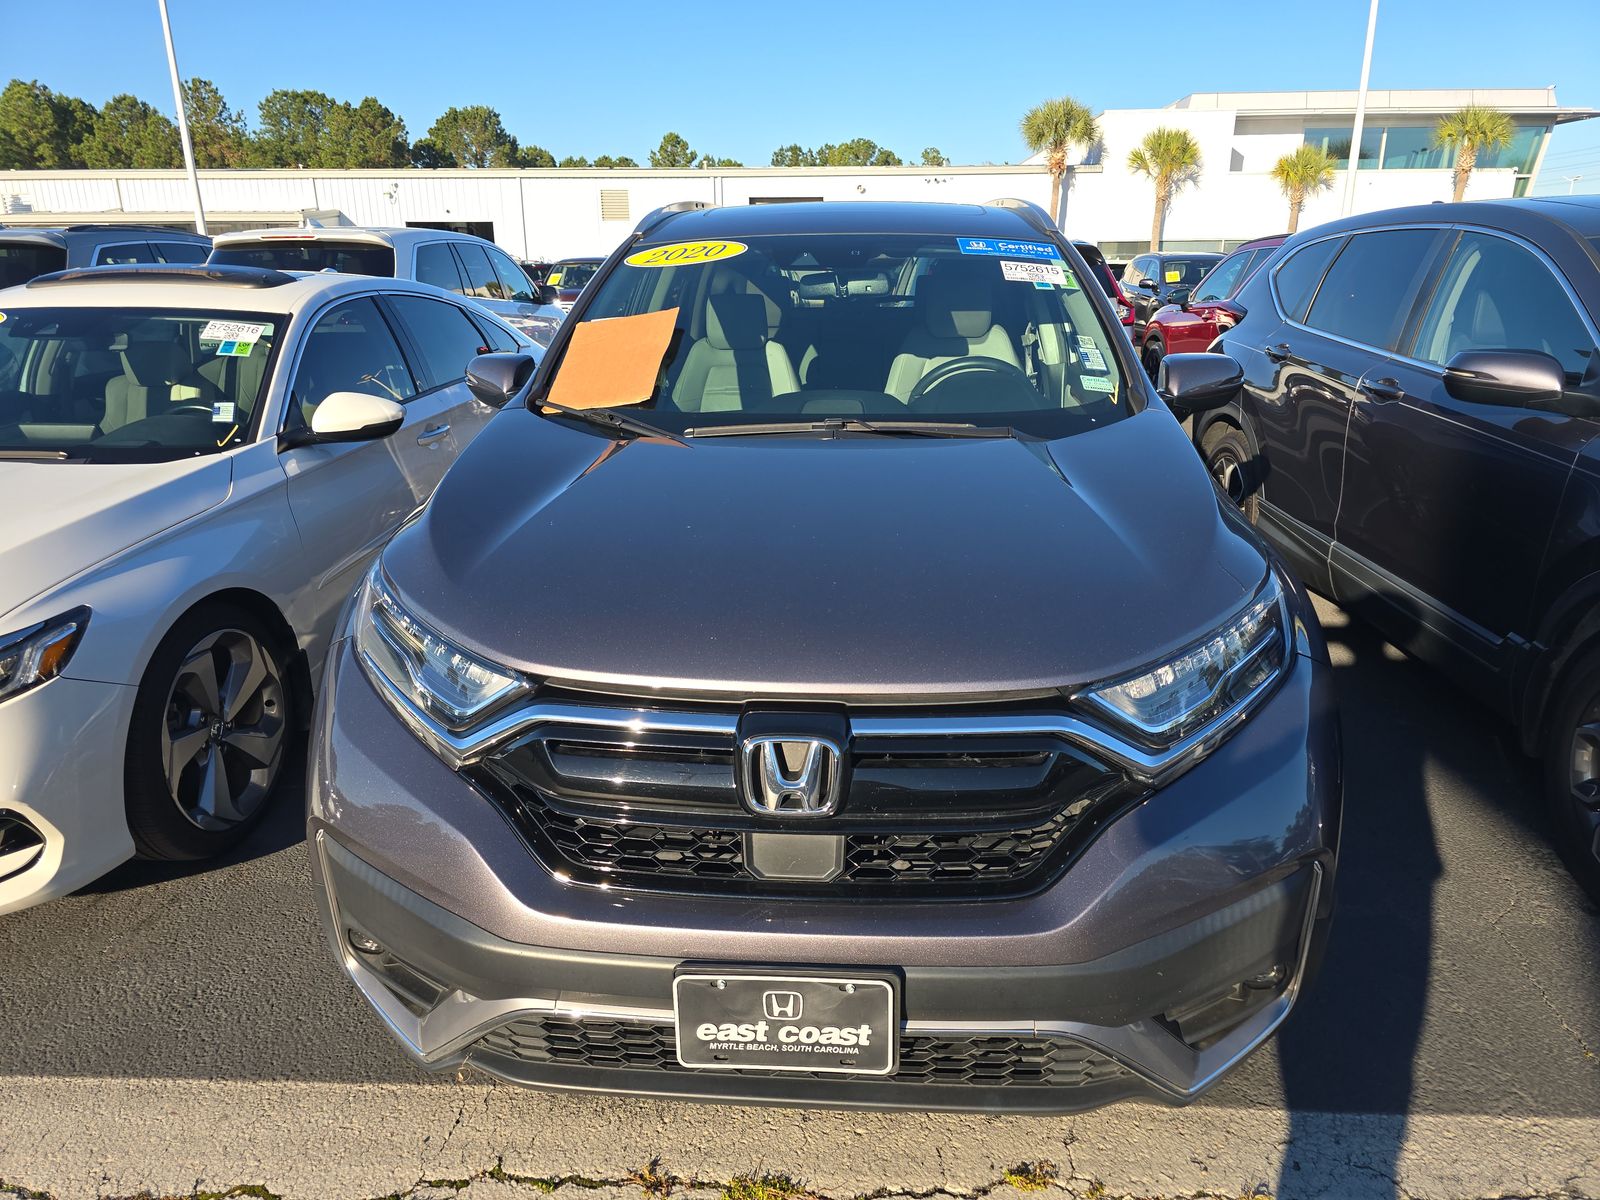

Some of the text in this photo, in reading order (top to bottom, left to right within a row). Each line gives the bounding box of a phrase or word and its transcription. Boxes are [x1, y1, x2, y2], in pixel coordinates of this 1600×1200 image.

[643, 244, 727, 264] 2020
[998, 242, 1053, 253] Certified
[1004, 263, 1060, 275] 5752615
[209, 322, 260, 335] 5752616
[696, 1020, 872, 1046] east coast
[709, 1042, 860, 1055] MYRTLE BEACH, SOUTH CAROLINA
